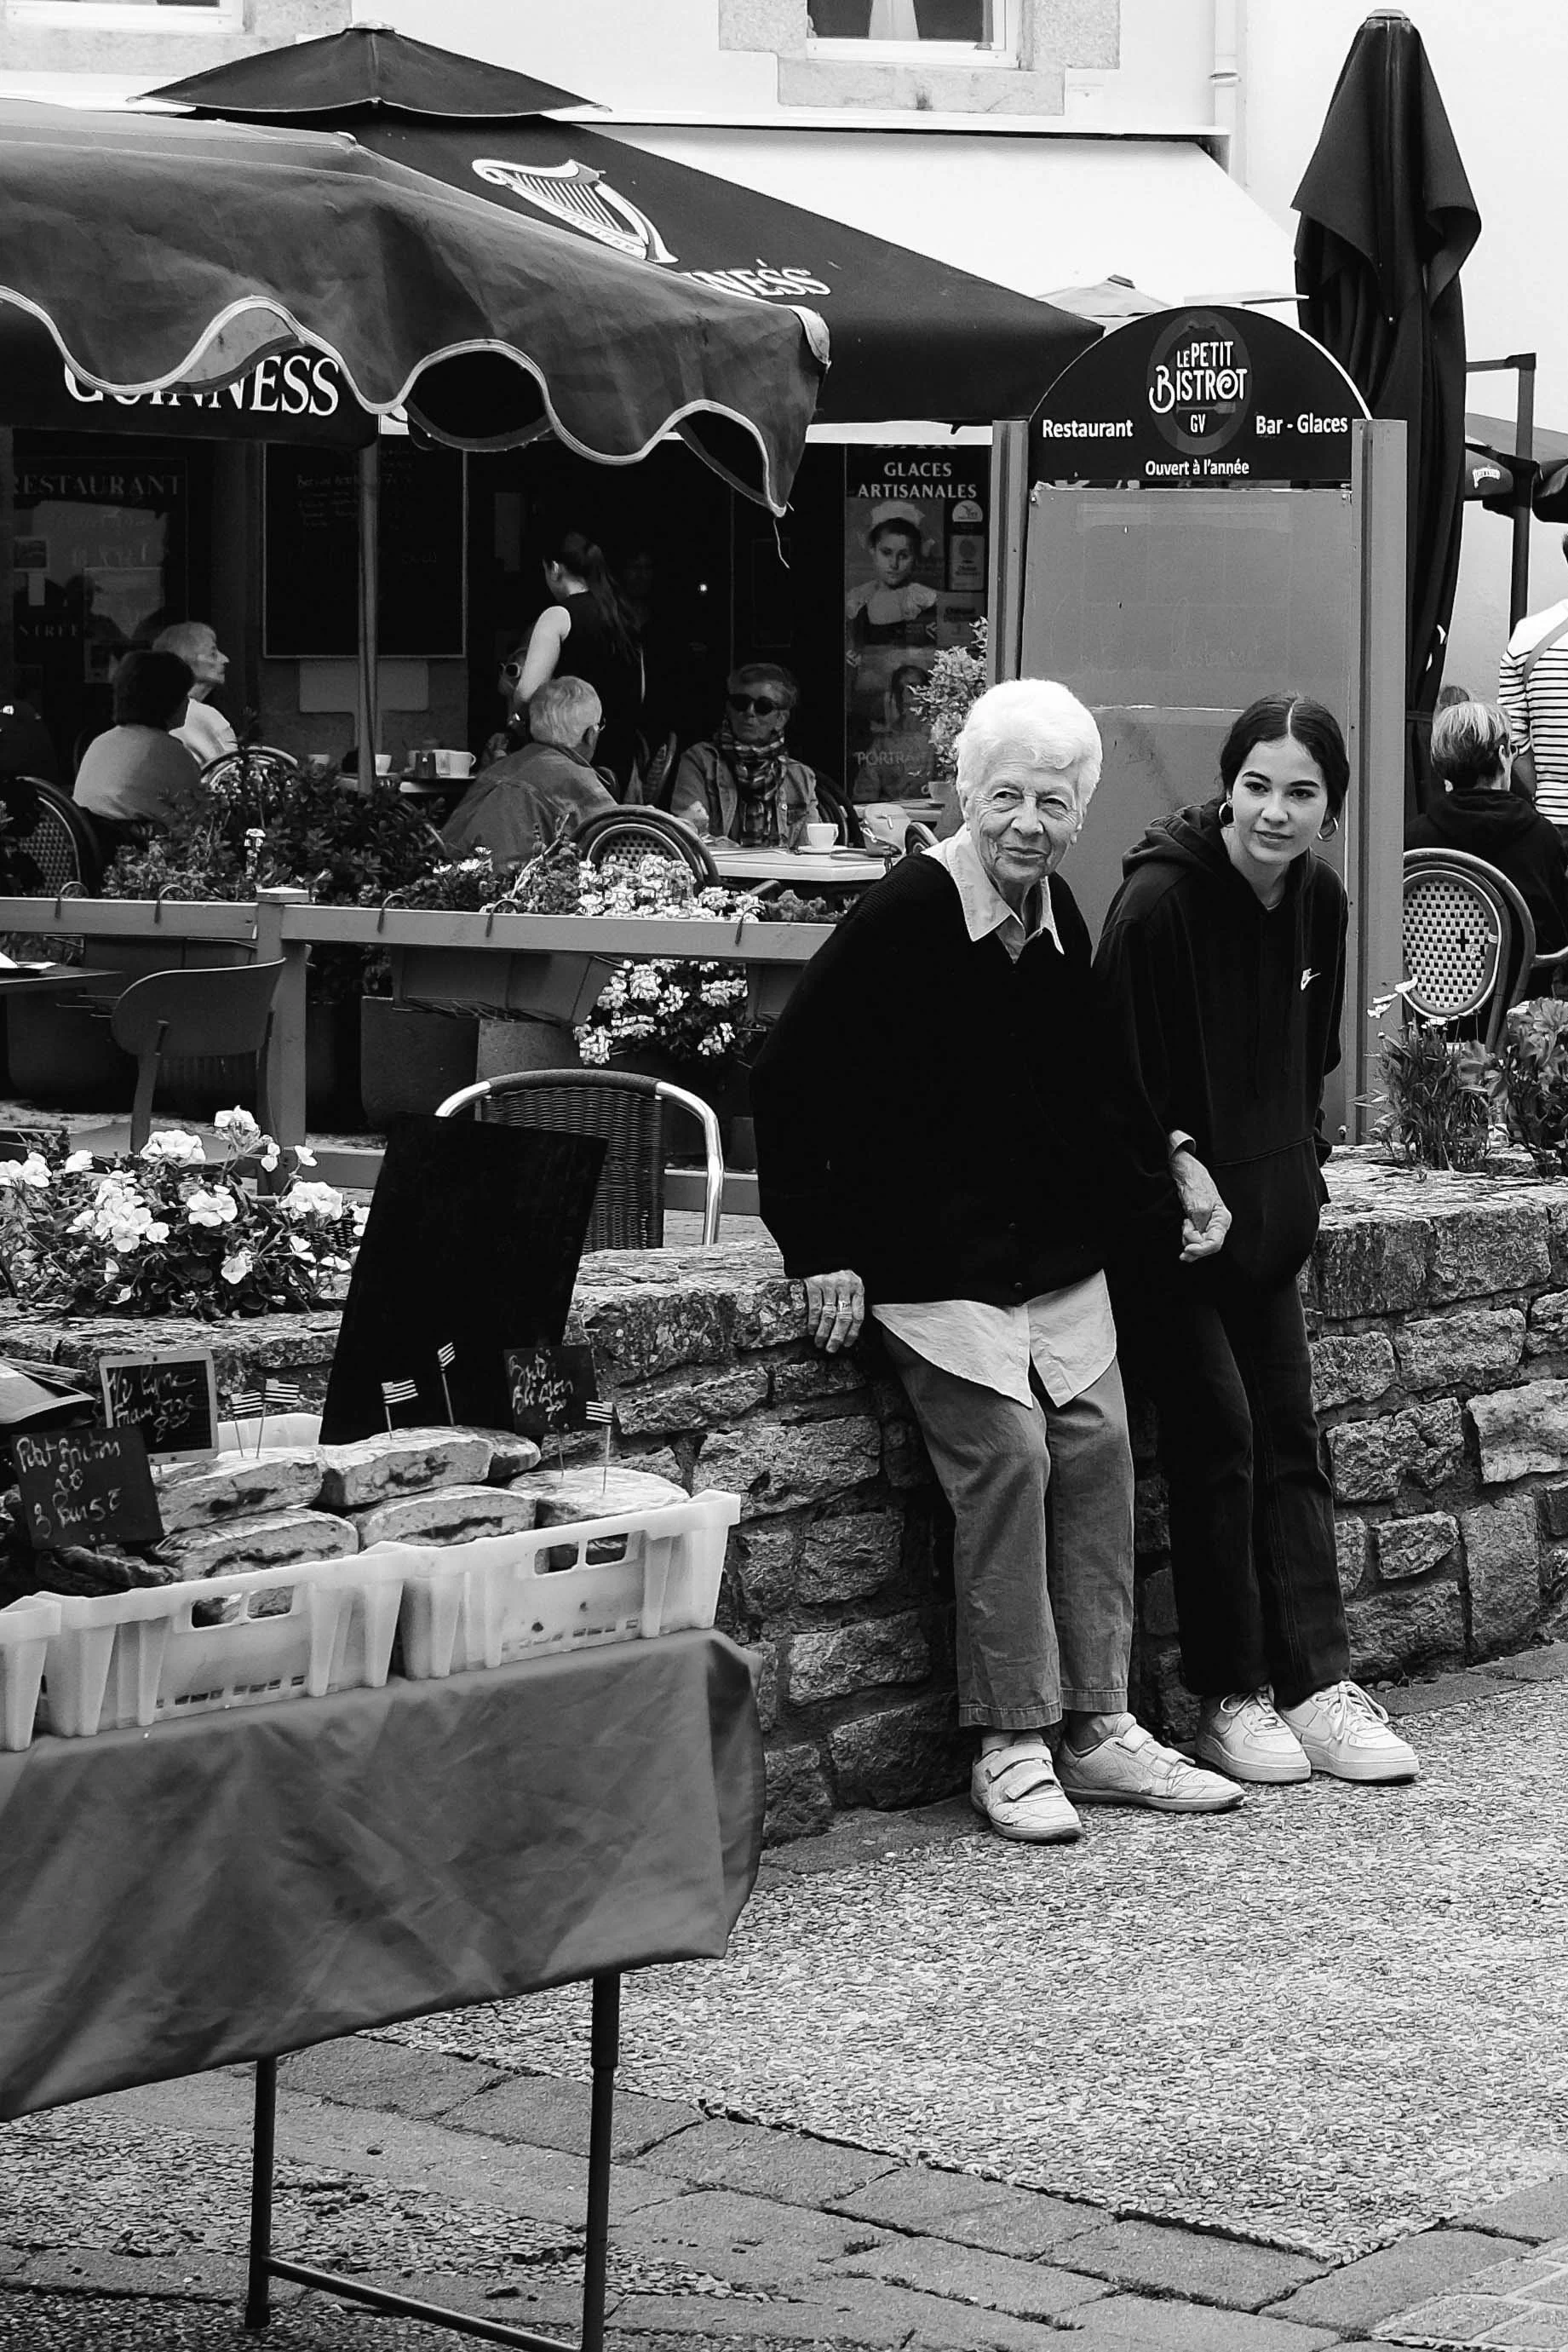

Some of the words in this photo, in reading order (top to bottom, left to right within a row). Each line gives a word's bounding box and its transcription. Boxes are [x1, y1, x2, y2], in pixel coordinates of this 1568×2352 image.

[1176, 350, 1190, 368] LE
[1191, 341, 1234, 367] PETIT
[1148, 365, 1248, 414] BISTROT
[1042, 419, 1134, 438] Restaurant
[1190, 414, 1206, 434] GV
[1255, 415, 1284, 434] Bar
[1296, 412, 1348, 434] Glaces
[883, 462, 952, 477] GLACES
[1145, 460, 1190, 476] Ouvert
[1192, 458, 1201, 475] à
[1203, 457, 1249, 476] l'année
[858, 484, 977, 498] ARTISANALES
